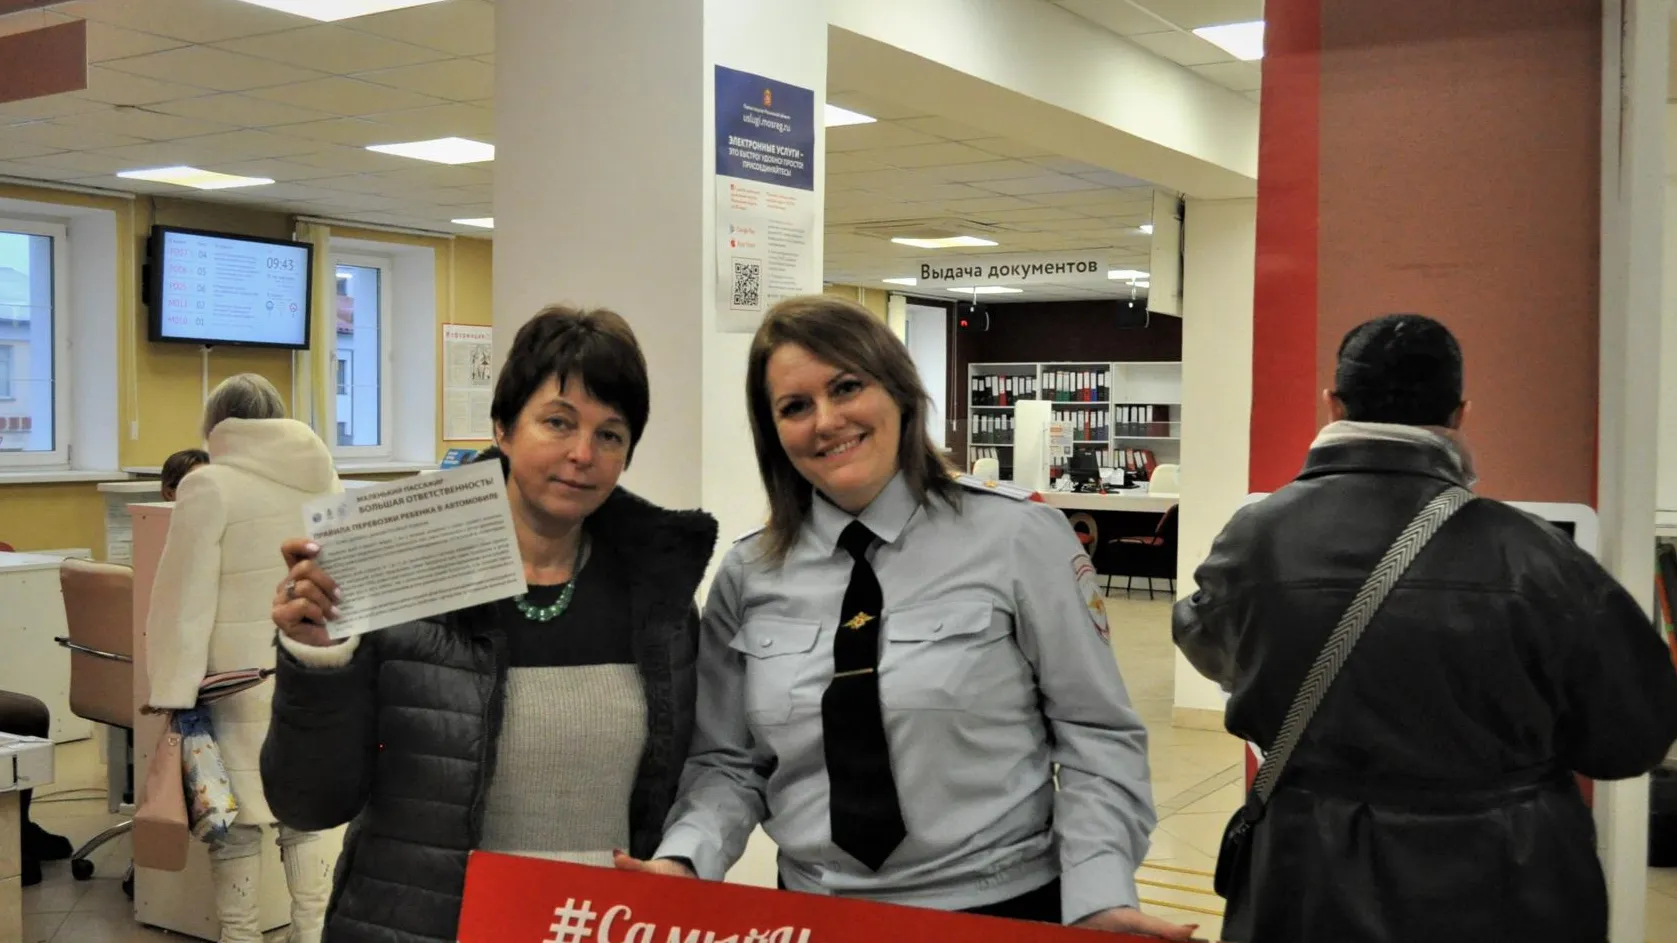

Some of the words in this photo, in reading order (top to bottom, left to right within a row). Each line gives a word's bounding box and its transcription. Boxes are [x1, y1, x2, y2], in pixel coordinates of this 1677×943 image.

[742, 113, 792, 133] uslugi.mosreg.ru
[728, 135, 775, 154] ЭЛЕКТРОННЫЕ
[776, 145, 799, 158] УСЛУГИ
[728, 147, 739, 156] ЭТО
[267, 257, 294, 271] 09:43
[921, 264, 982, 281] Выдача
[988, 260, 1098, 280] документов
[356, 487, 402, 503] МАЛЕНЬКИЙ
[358, 497, 405, 514] БОЛЬШАЯ
[313, 525, 350, 541] ПРАВИЛА
[351, 514, 400, 532] ПЕРЕВОЗКИ
[400, 506, 436, 520] РЕБЕНКА
[444, 491, 499, 509] АВТОМОБИЛЕ
